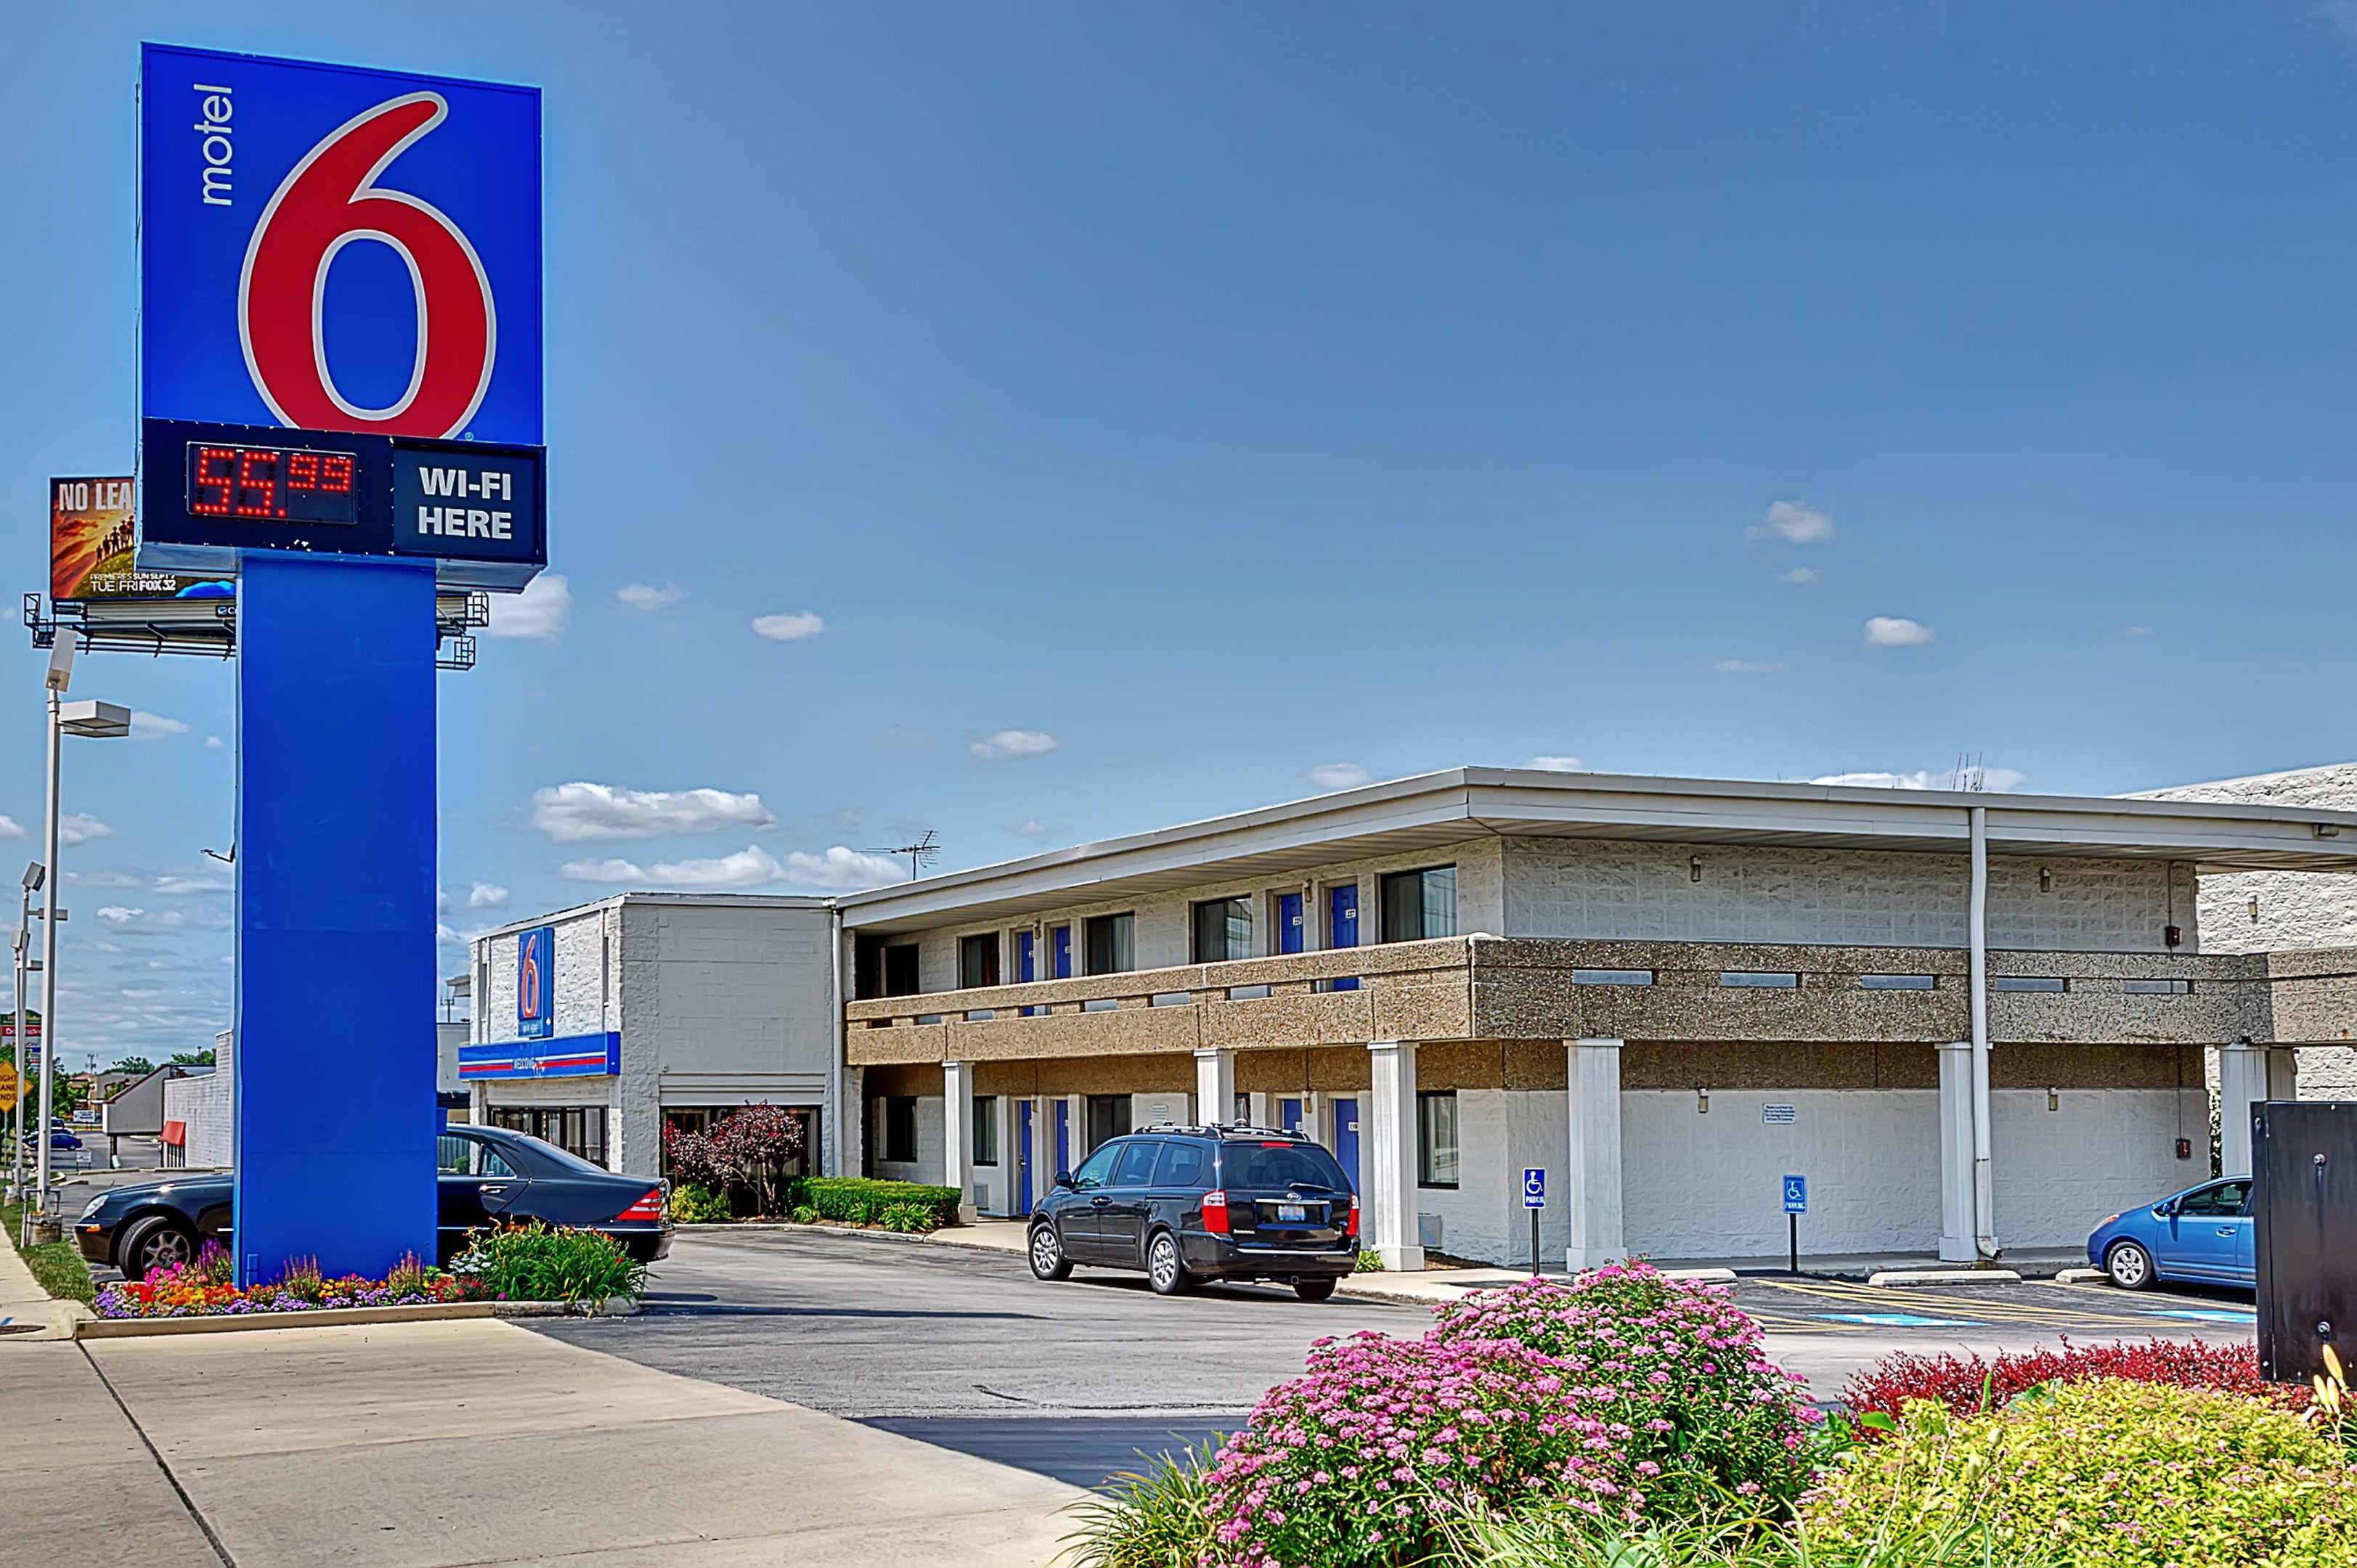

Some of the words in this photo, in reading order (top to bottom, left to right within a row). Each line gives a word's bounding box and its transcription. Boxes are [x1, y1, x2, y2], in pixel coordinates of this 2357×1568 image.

[193, 83, 232, 206] motel
[237, 91, 497, 439] 6
[59, 483, 89, 511] NO
[95, 482, 134, 510] LEA
[419, 467, 511, 501] WI-FI
[419, 506, 512, 539] HERE
[91, 581, 115, 592] TUE
[119, 581, 138, 591] FRI
[521, 934, 538, 1018] 6
